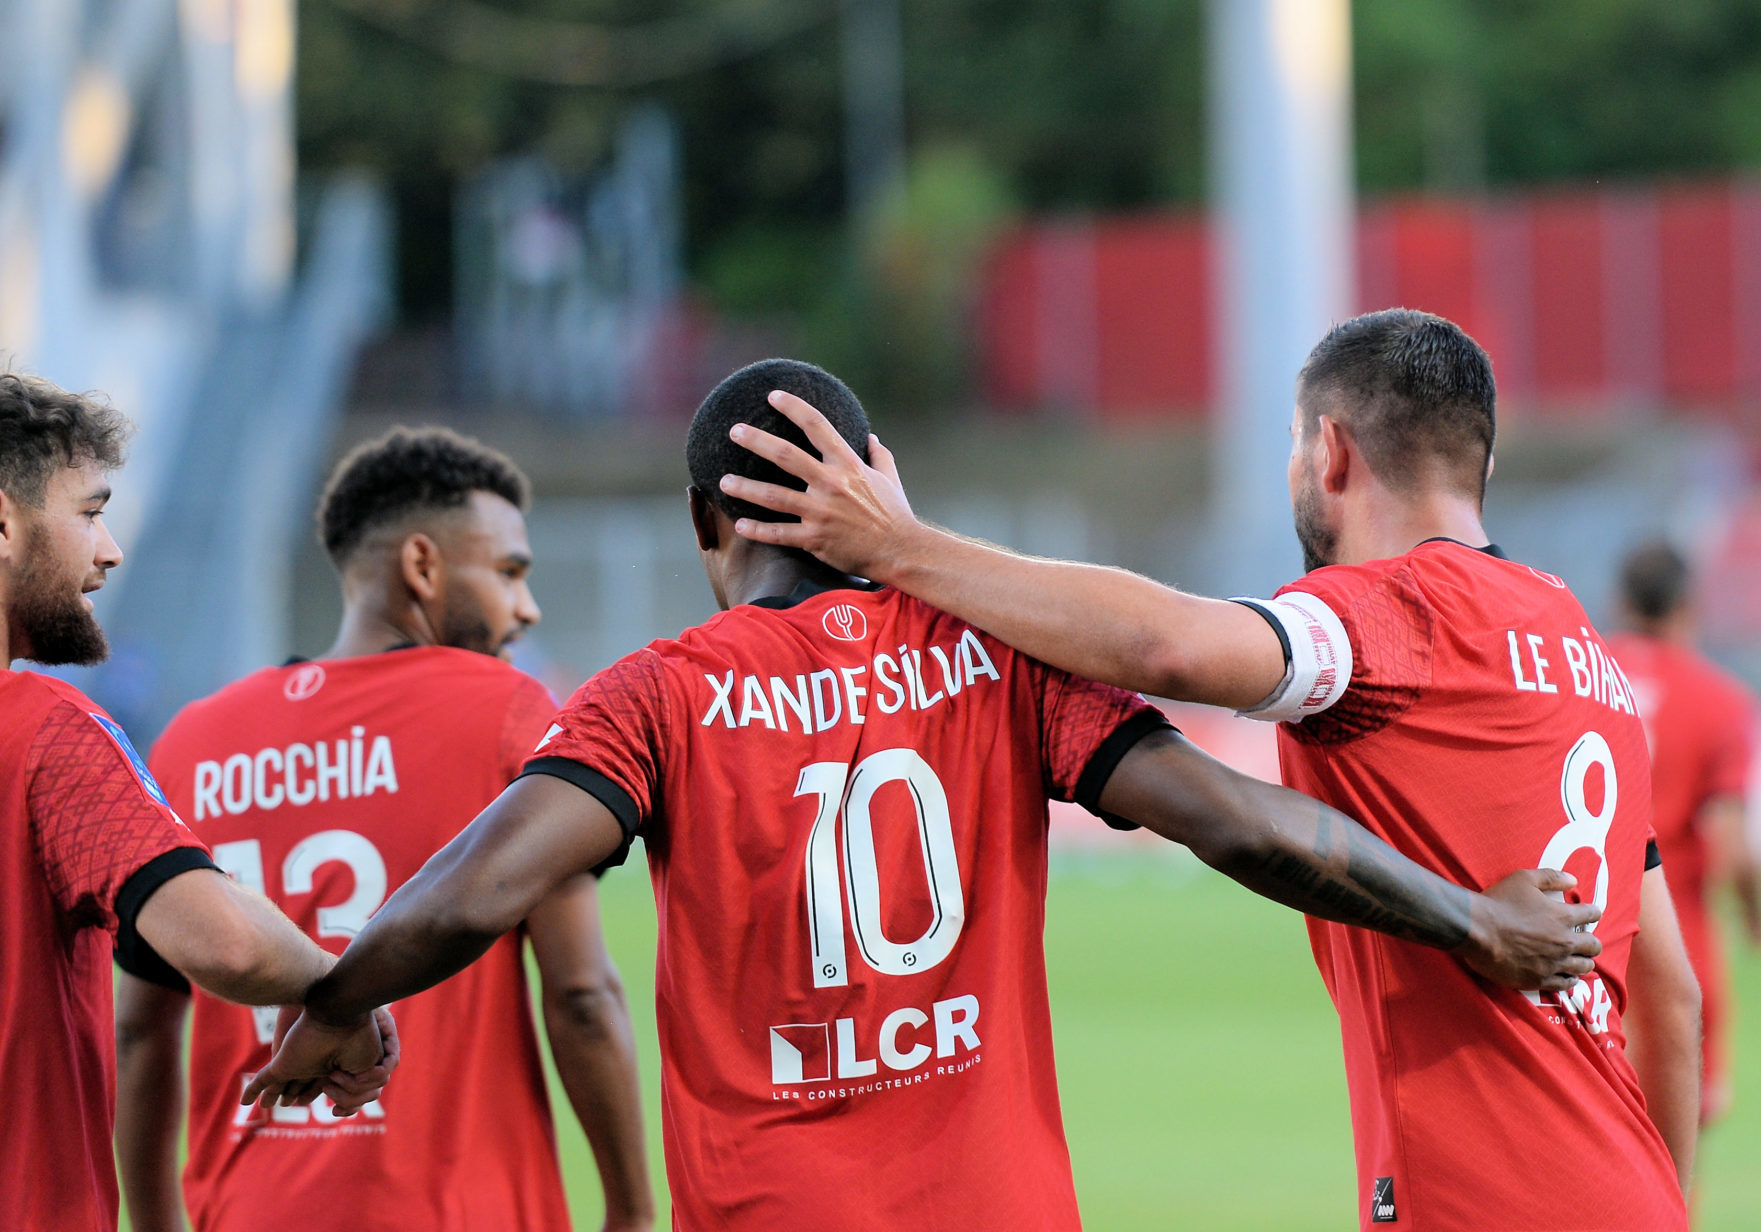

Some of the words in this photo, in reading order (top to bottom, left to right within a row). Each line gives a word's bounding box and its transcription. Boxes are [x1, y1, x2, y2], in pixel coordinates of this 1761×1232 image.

[1507, 630, 1559, 694] LE
[701, 666, 867, 735] XANDE
[793, 748, 965, 988] 10
[1537, 731, 1618, 933] 8
[836, 994, 982, 1078] LCR
[772, 1090, 800, 1100] LES
[808, 1071, 930, 1100] CONSTRUCTEURS
[937, 1054, 982, 1075] REUNIS
